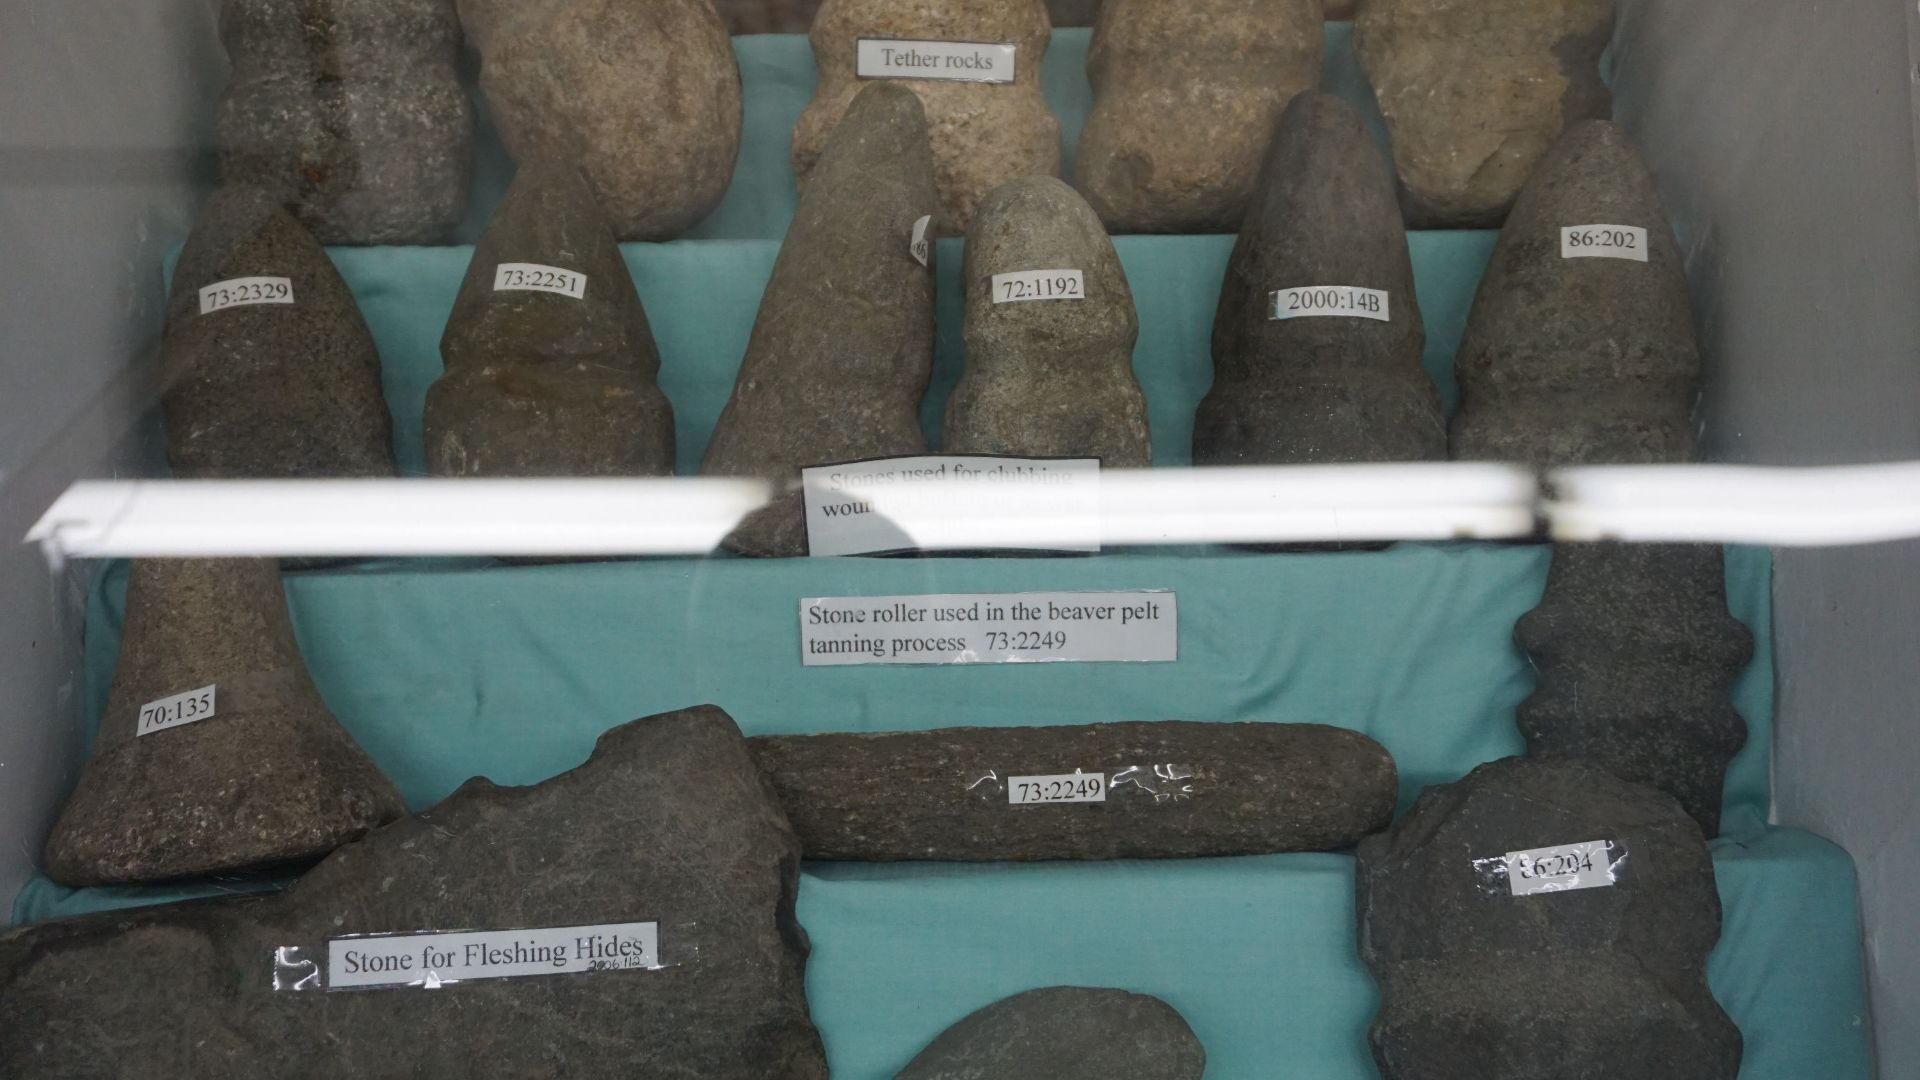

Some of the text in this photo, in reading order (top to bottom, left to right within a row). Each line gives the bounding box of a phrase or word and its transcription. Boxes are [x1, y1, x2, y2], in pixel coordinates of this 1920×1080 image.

[881, 48, 993, 70] Tether rocks
[1569, 230, 1636, 249] 86:202
[503, 270, 577, 292] 73:2251
[1002, 277, 1079, 299] 72:1192
[207, 283, 288, 309] 73:2329
[1288, 290, 1380, 312] 2000:14B
[830, 464, 1073, 491] Stones used for clubbing
[809, 601, 1160, 625] Stone roller used in the beaver pelt
[809, 631, 1067, 657] tanning process 73:2249
[143, 692, 210, 728] 70:135
[1018, 778, 1101, 802] 73:2249
[344, 934, 643, 974] Stone for Fleshing Hides
